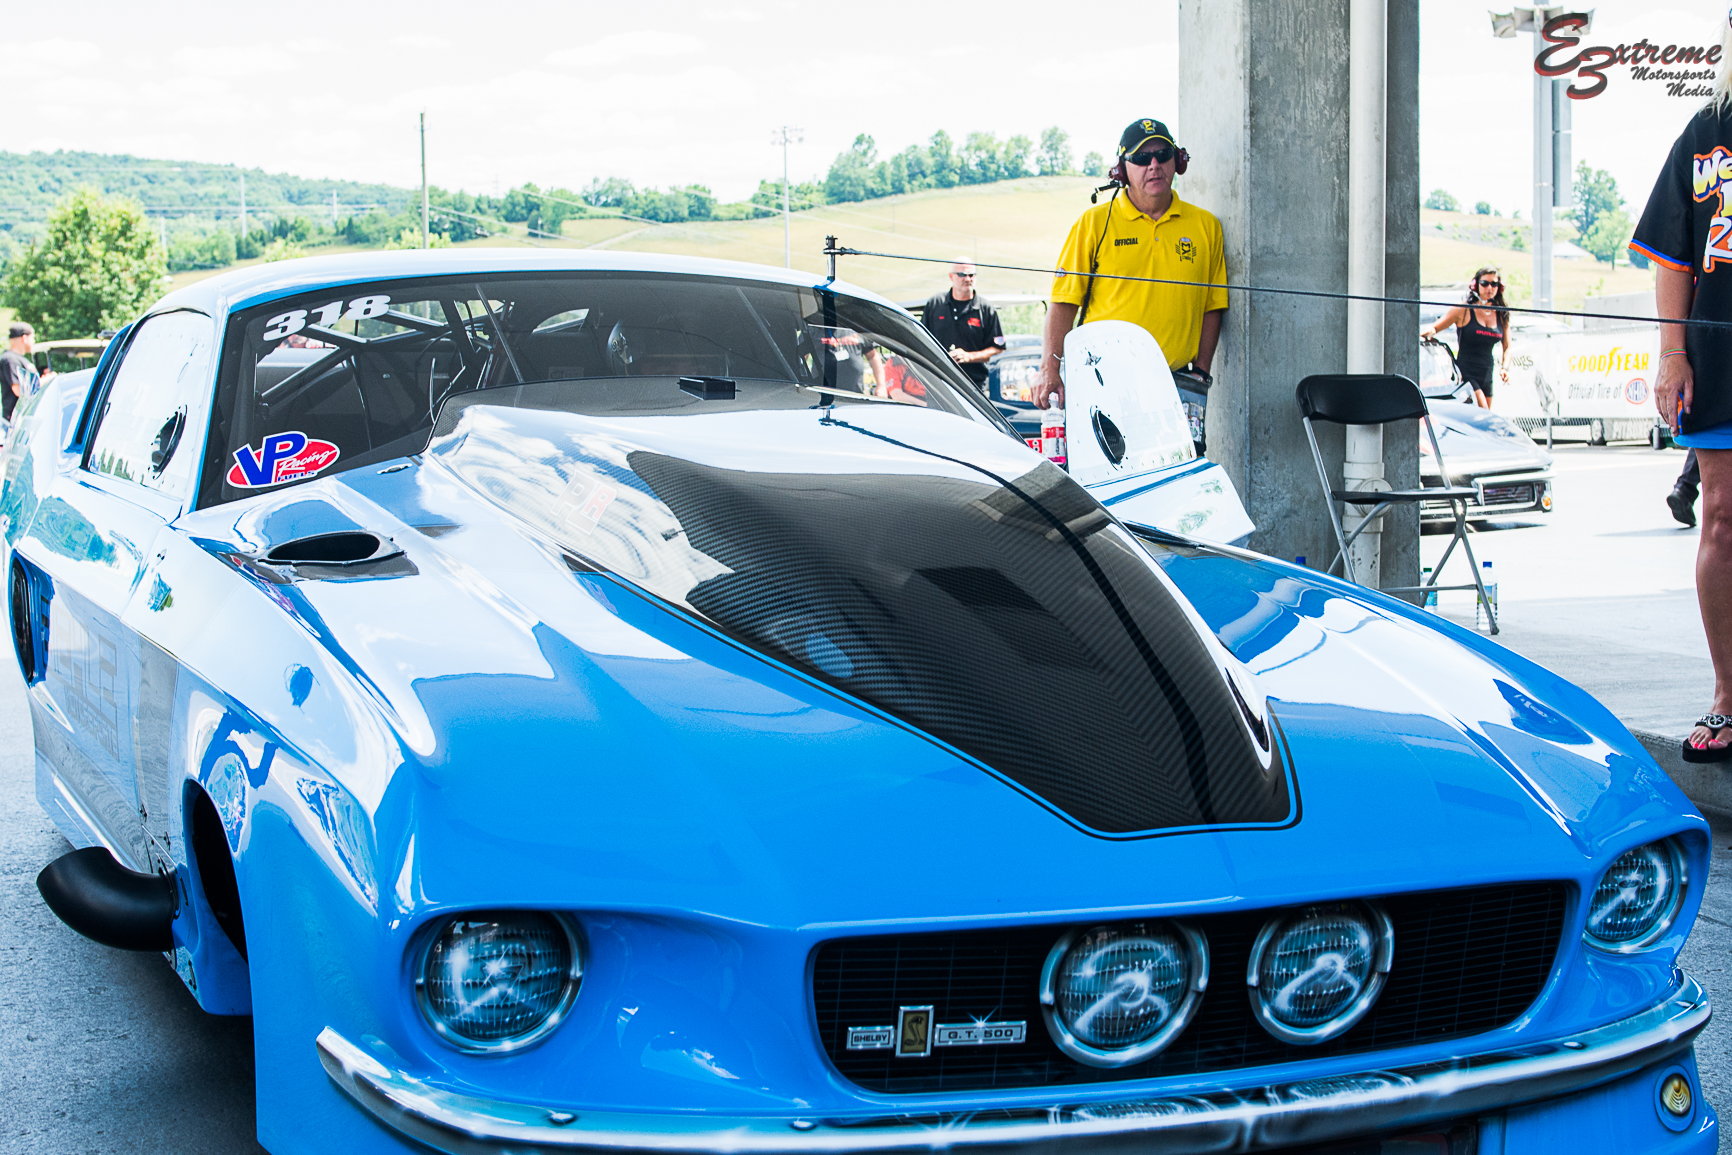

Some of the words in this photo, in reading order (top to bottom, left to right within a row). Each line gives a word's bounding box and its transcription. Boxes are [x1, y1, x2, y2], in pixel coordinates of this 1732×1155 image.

[1114, 237, 1138, 246] OFFICIAL
[263, 295, 391, 341] 318
[1568, 347, 1650, 377] GOODYEAR
[1568, 383, 1595, 399] Official
[1597, 383, 1611, 399] Tire
[1613, 382, 1622, 399] of
[234, 431, 307, 486] VP
[278, 450, 334, 476] Racing
[854, 1034, 887, 1043] SHELBY
